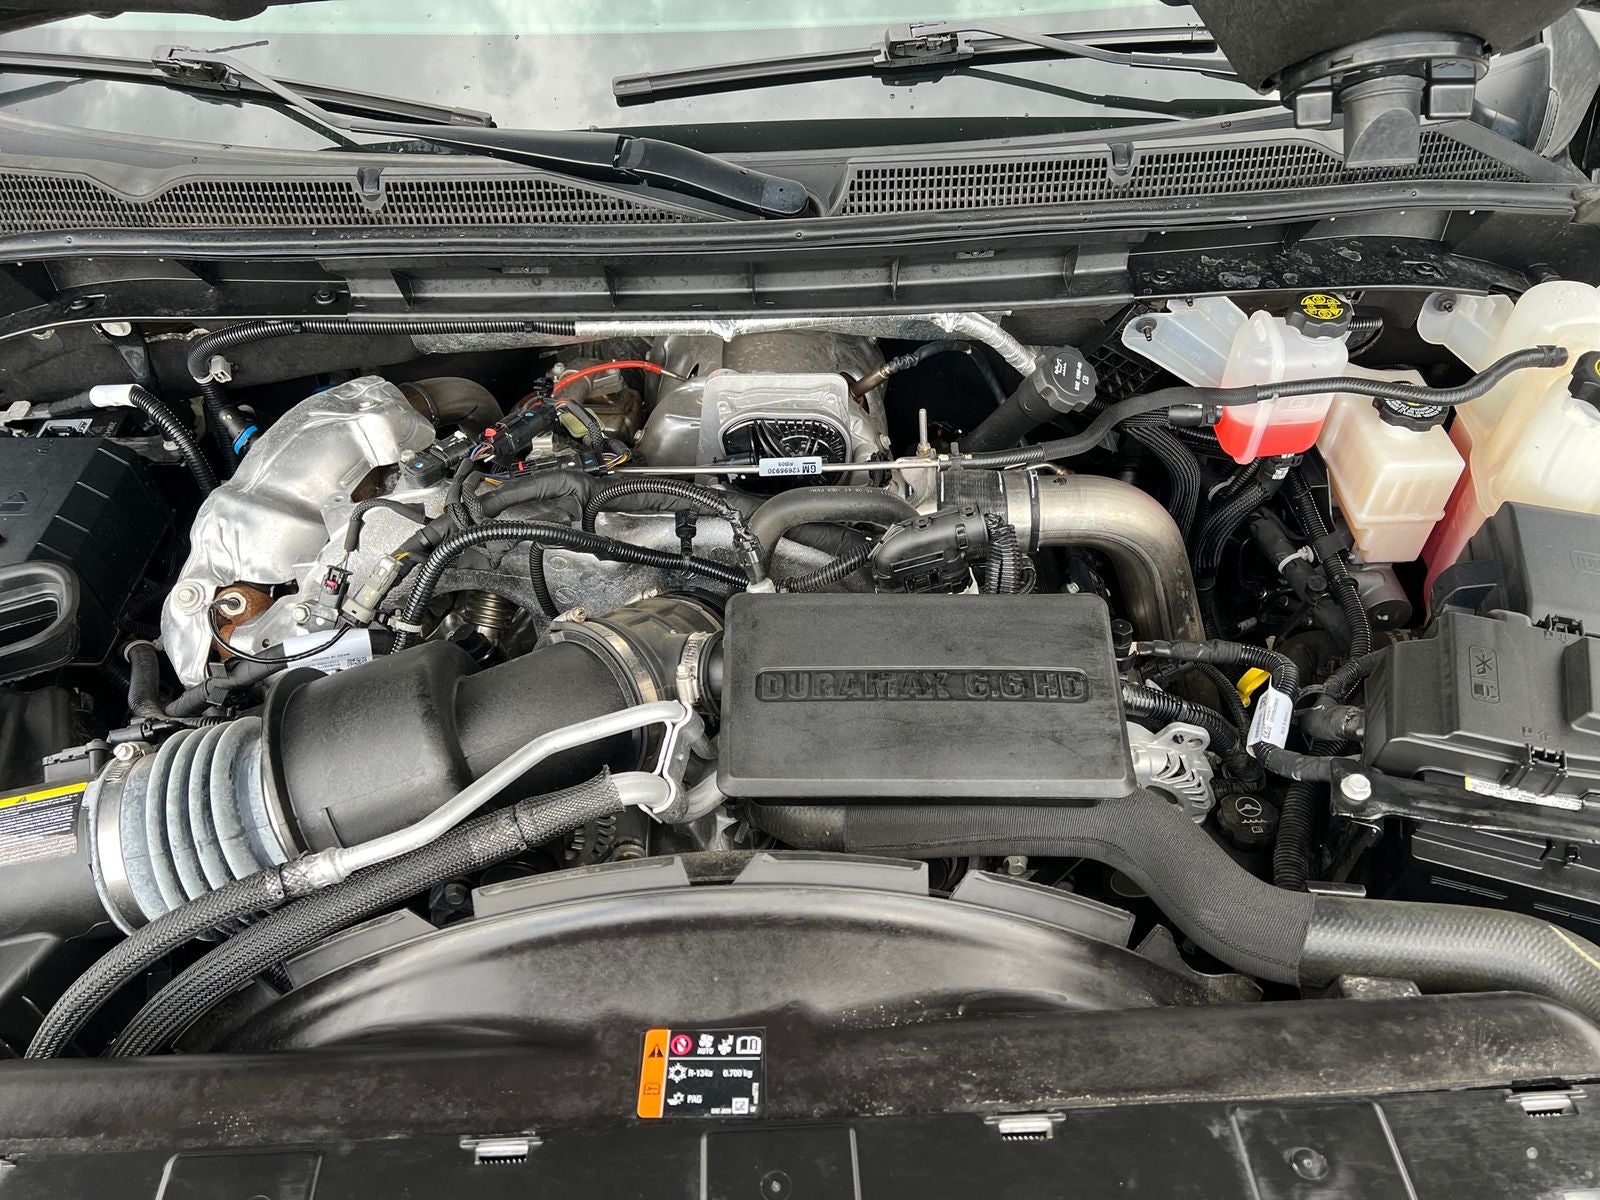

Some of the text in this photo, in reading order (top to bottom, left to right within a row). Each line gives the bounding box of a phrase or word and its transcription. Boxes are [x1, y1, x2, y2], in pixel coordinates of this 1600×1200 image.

[802, 464, 817, 474] GM
[761, 671, 1084, 700] DURAMAX 6.6 HD
[696, 1047, 715, 1055] AUTO
[687, 1068, 714, 1078] R-134a
[743, 1069, 753, 1079] kg
[686, 1094, 703, 1104] PAG
